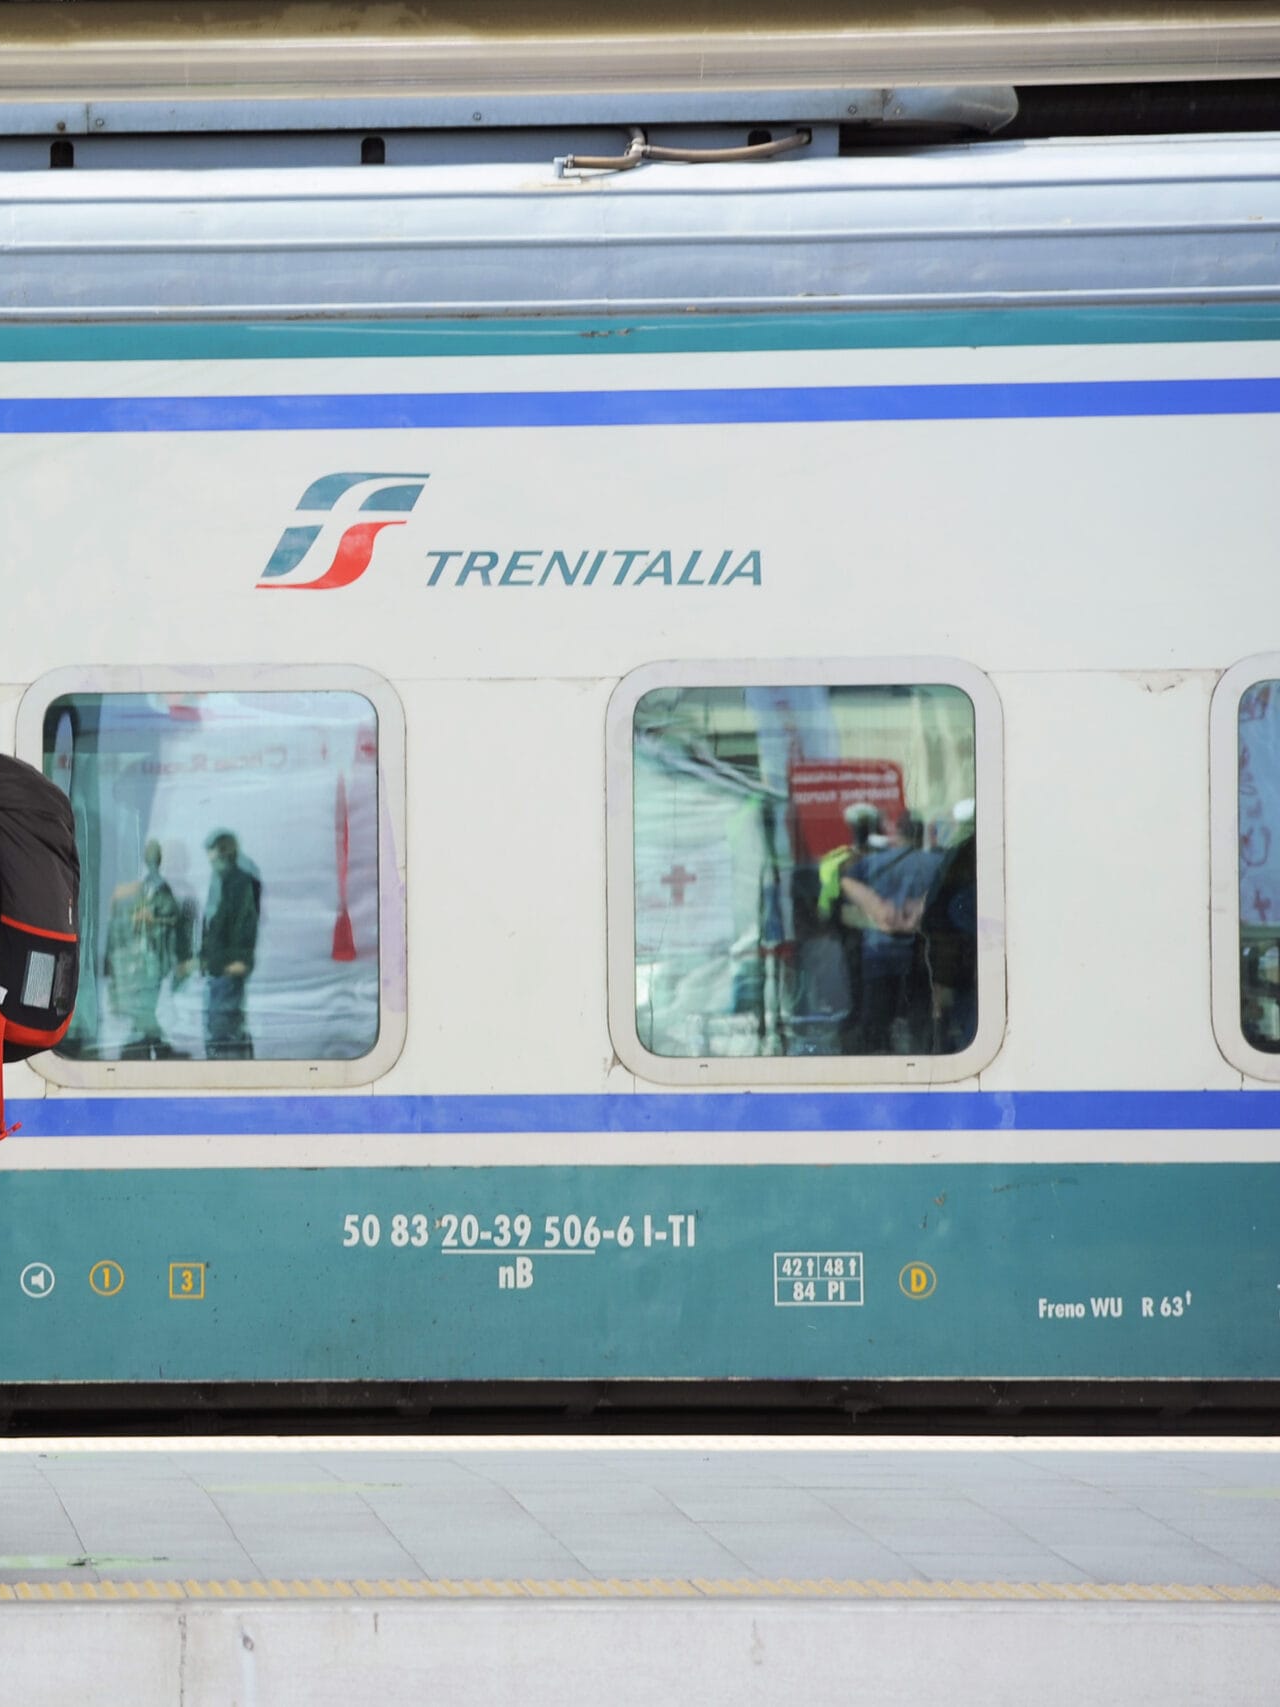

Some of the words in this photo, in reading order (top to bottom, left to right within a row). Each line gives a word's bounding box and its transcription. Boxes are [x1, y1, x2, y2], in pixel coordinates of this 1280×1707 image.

[426, 549, 762, 587] TRENITALIA
[342, 1214, 381, 1248] 50
[390, 1214, 429, 1248] 83
[441, 1214, 532, 1248] 20-39
[544, 1214, 635, 1248] 506-6
[643, 1214, 695, 1248] I-TI
[180, 1270, 194, 1292] 3
[498, 1256, 534, 1289] nB
[910, 1268, 927, 1293] D
[792, 1281, 816, 1301] 84
[1038, 1298, 1086, 1318] Freno
[1090, 1297, 1123, 1318] WU
[1142, 1297, 1154, 1317] R
